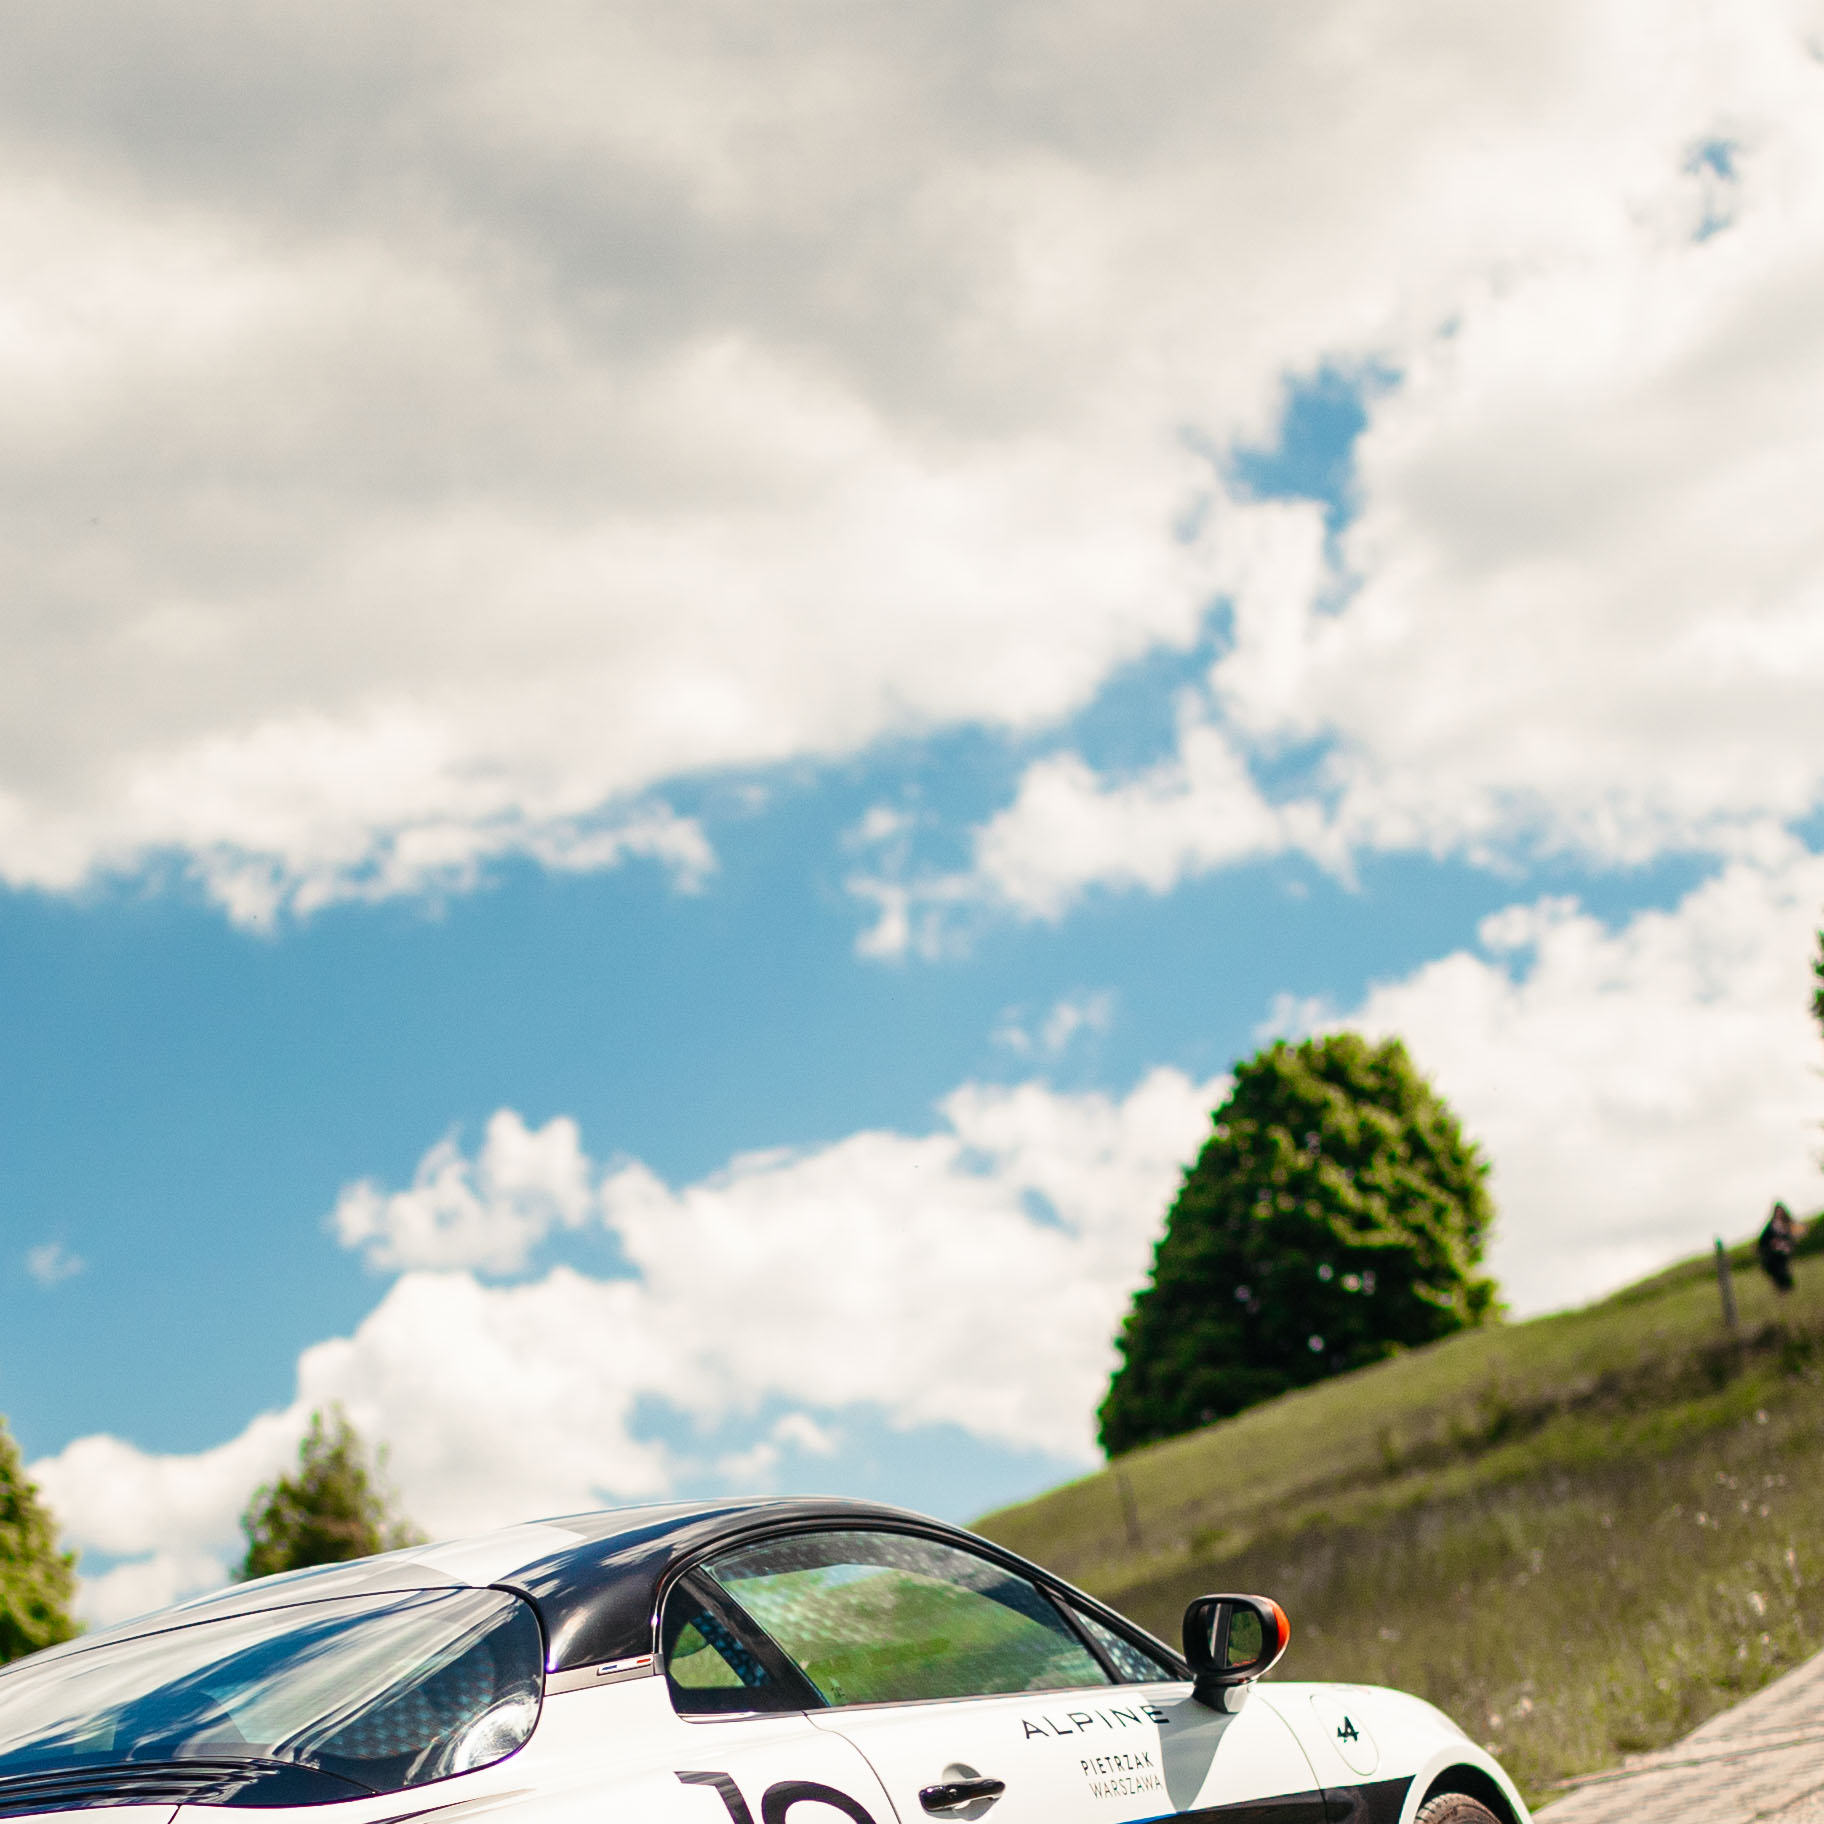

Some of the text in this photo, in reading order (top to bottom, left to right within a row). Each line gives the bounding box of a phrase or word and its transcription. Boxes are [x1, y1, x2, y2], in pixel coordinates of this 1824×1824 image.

[1021, 1704, 1170, 1739] ALPINE
[1080, 1751, 1154, 1776] PIETRZAK
[1089, 1775, 1164, 1799] WARSZAWA
